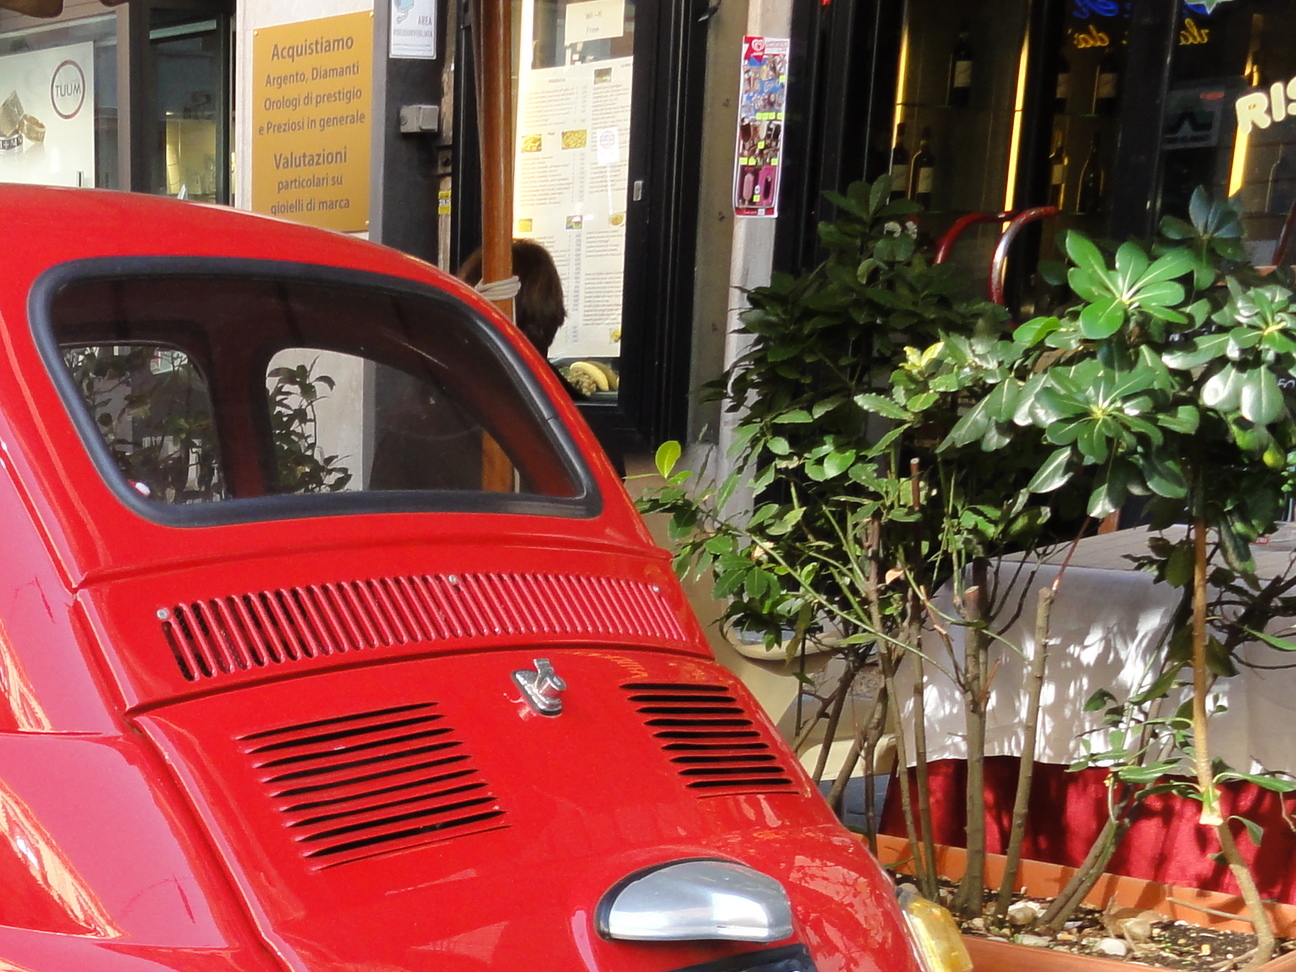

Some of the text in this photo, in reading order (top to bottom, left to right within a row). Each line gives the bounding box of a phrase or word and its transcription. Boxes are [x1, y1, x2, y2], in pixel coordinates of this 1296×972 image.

[417, 15, 432, 26] AREA
[271, 36, 354, 62] Acquistiamo
[265, 61, 360, 89] Argento, Diamanti
[55, 83, 81, 98] TUUM
[264, 88, 362, 112] Orologi di prestigio
[258, 110, 366, 136] e Preziosi in generale
[273, 146, 347, 170] Valutazioni
[277, 173, 343, 194] particolari su
[270, 197, 350, 216] gioielli di marca
